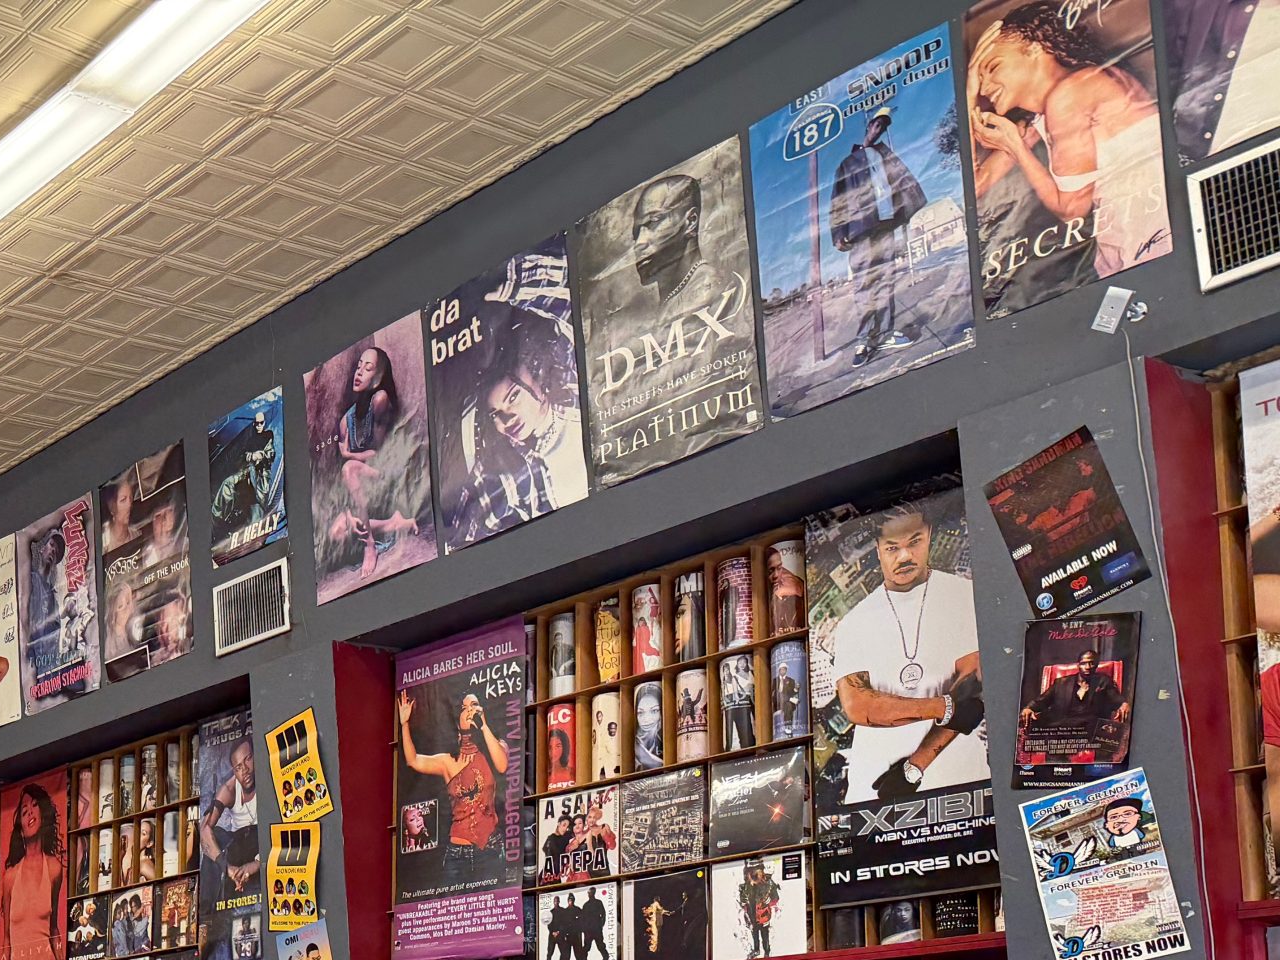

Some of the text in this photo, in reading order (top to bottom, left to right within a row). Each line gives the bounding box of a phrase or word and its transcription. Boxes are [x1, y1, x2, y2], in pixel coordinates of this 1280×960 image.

[847, 38, 943, 101] SNOOP
[796, 86, 823, 109] EAST
[843, 57, 950, 118] doggy dogg
[793, 113, 835, 152] 187
[985, 182, 1162, 283] SECRETS
[430, 298, 460, 333] da
[432, 317, 483, 365] brat
[595, 274, 748, 404] DMX
[597, 404, 618, 421] THE
[620, 386, 663, 414] STREETS
[666, 369, 697, 391] HAVE
[315, 434, 339, 452] sade
[242, 512, 282, 543] KELLY
[144, 557, 190, 585] OFF THE HOOK
[1041, 540, 1118, 589] AVAILABLE NOW
[403, 641, 518, 685] ALICIA BARES HER SOUL.
[469, 661, 522, 686] ALICIA
[485, 678, 522, 700] KEYS
[505, 750, 521, 862] UNPLUGGED
[1032, 781, 1139, 820] FOREVER GRINDIN
[561, 848, 608, 874] PEPA
[830, 870, 851, 885] IN
[1049, 859, 1159, 894] FOREVER GRINDIN
[216, 896, 257, 911] IN STORES
[412, 888, 435, 898] ultimate
[450, 882, 464, 891] artist
[466, 878, 498, 890] experience
[285, 934, 299, 946] OMI
[1146, 933, 1186, 953] NOW
